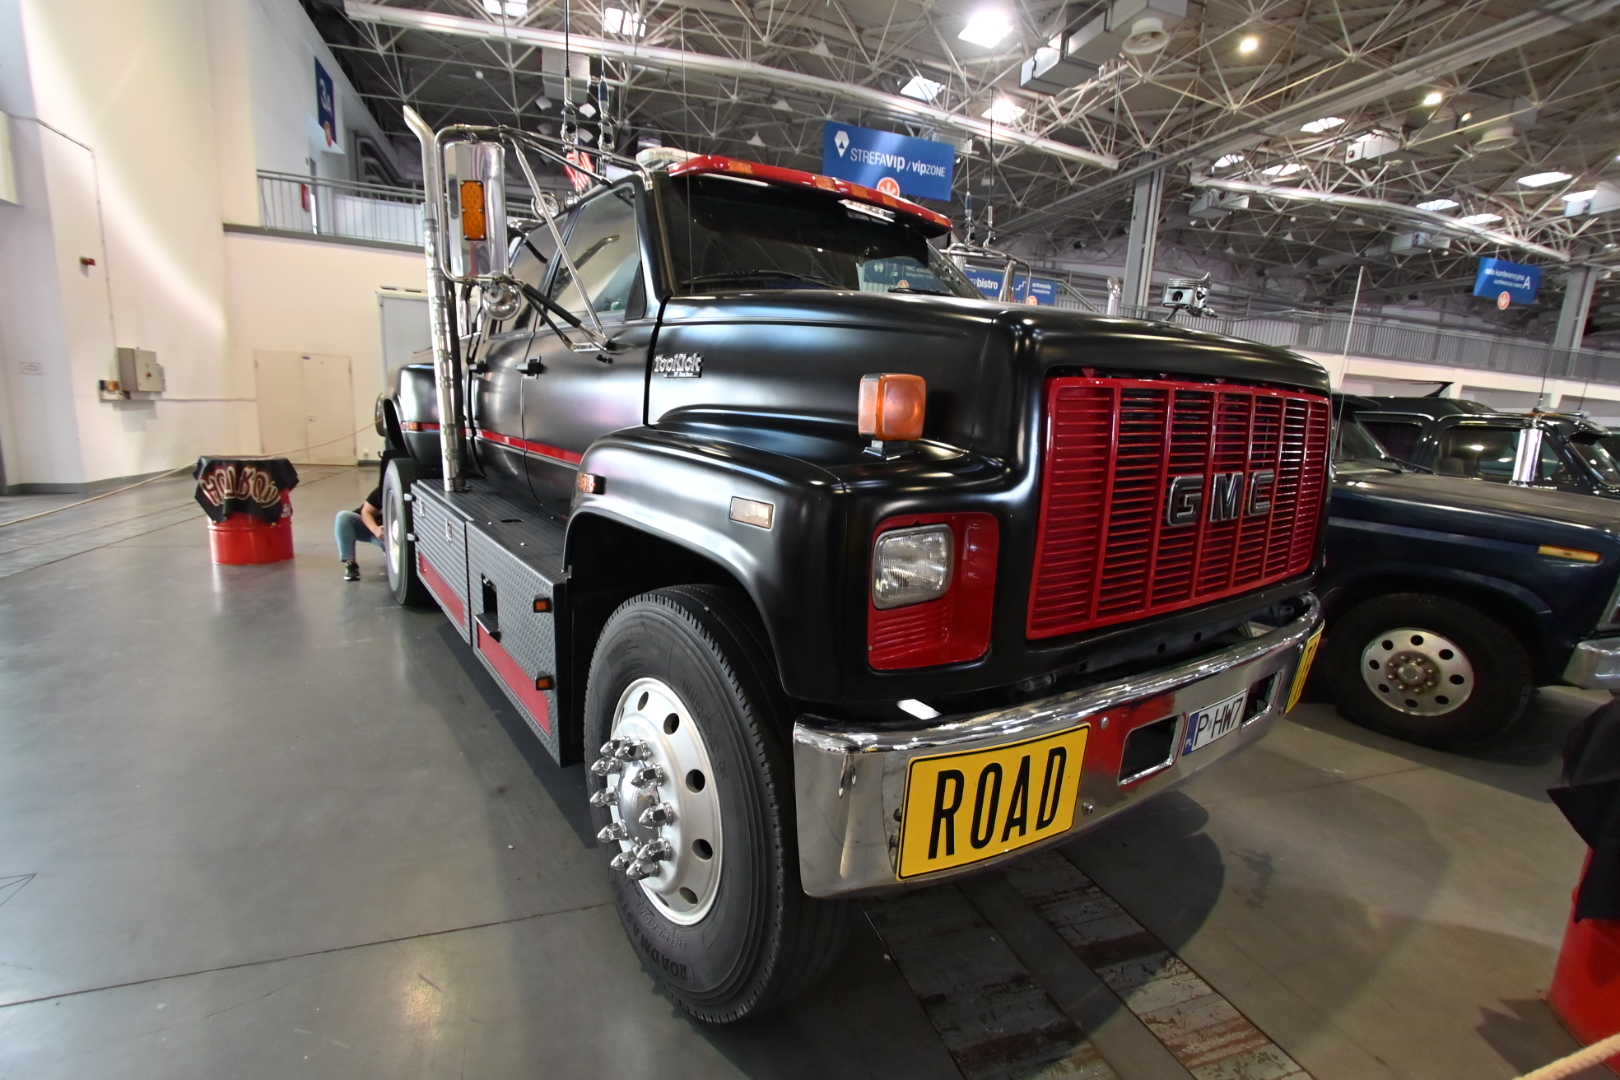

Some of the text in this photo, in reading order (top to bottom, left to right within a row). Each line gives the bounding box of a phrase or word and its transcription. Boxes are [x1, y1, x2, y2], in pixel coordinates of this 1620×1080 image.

[1522, 276, 1531, 290] A
[654, 352, 702, 376] TopKick
[1166, 469, 1275, 528] GMC
[927, 746, 1068, 860] ROAD
